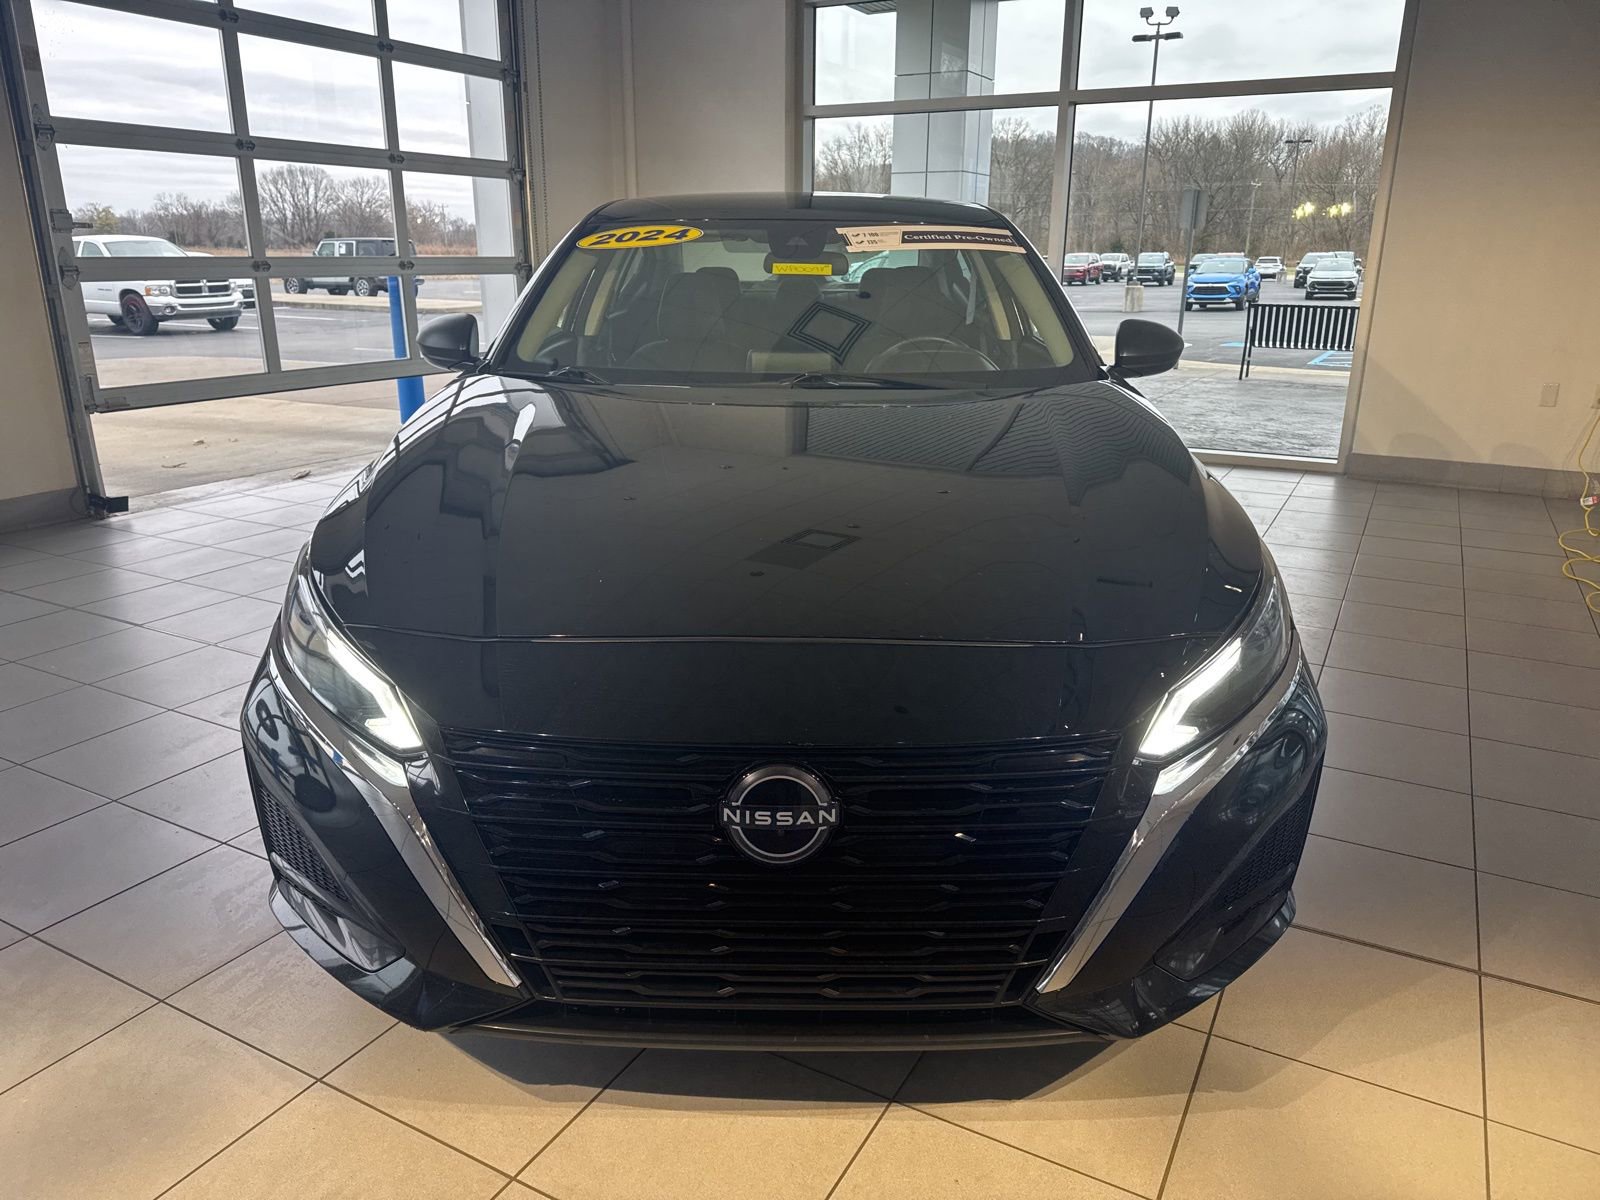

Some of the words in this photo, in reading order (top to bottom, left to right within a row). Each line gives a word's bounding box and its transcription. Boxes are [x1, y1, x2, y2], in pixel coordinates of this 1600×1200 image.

[588, 229, 691, 246] 2024
[903, 233, 952, 241] Certified
[953, 234, 1014, 244] Pre-Owned
[723, 807, 836, 826] NISSAN
